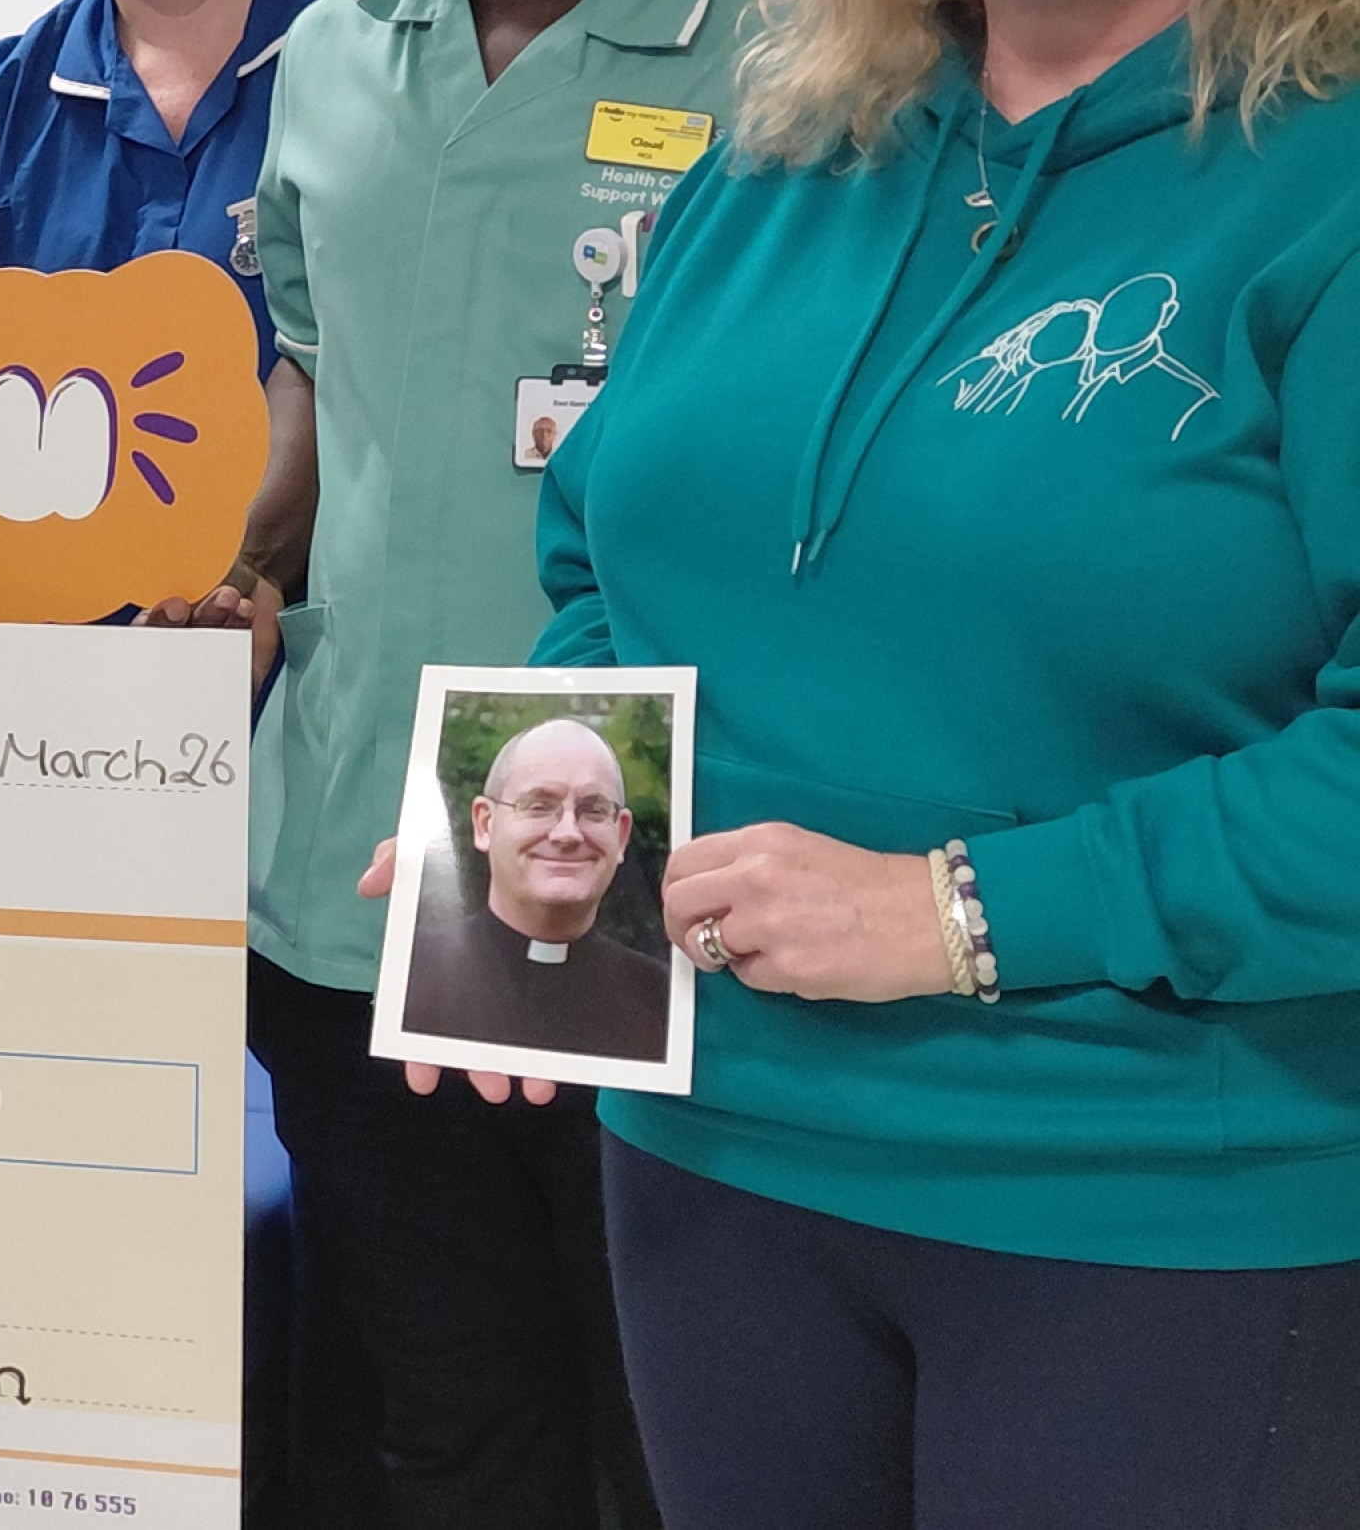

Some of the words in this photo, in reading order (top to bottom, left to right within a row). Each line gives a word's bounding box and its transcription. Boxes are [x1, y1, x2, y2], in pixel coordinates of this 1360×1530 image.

[630, 137, 665, 150] Cloud
[602, 166, 656, 188] Health
[580, 182, 647, 205] Support
[0, 732, 167, 785] March
[169, 732, 236, 788] 26
[61, 1491, 88, 1511] 76
[94, 1494, 137, 1516] 555
